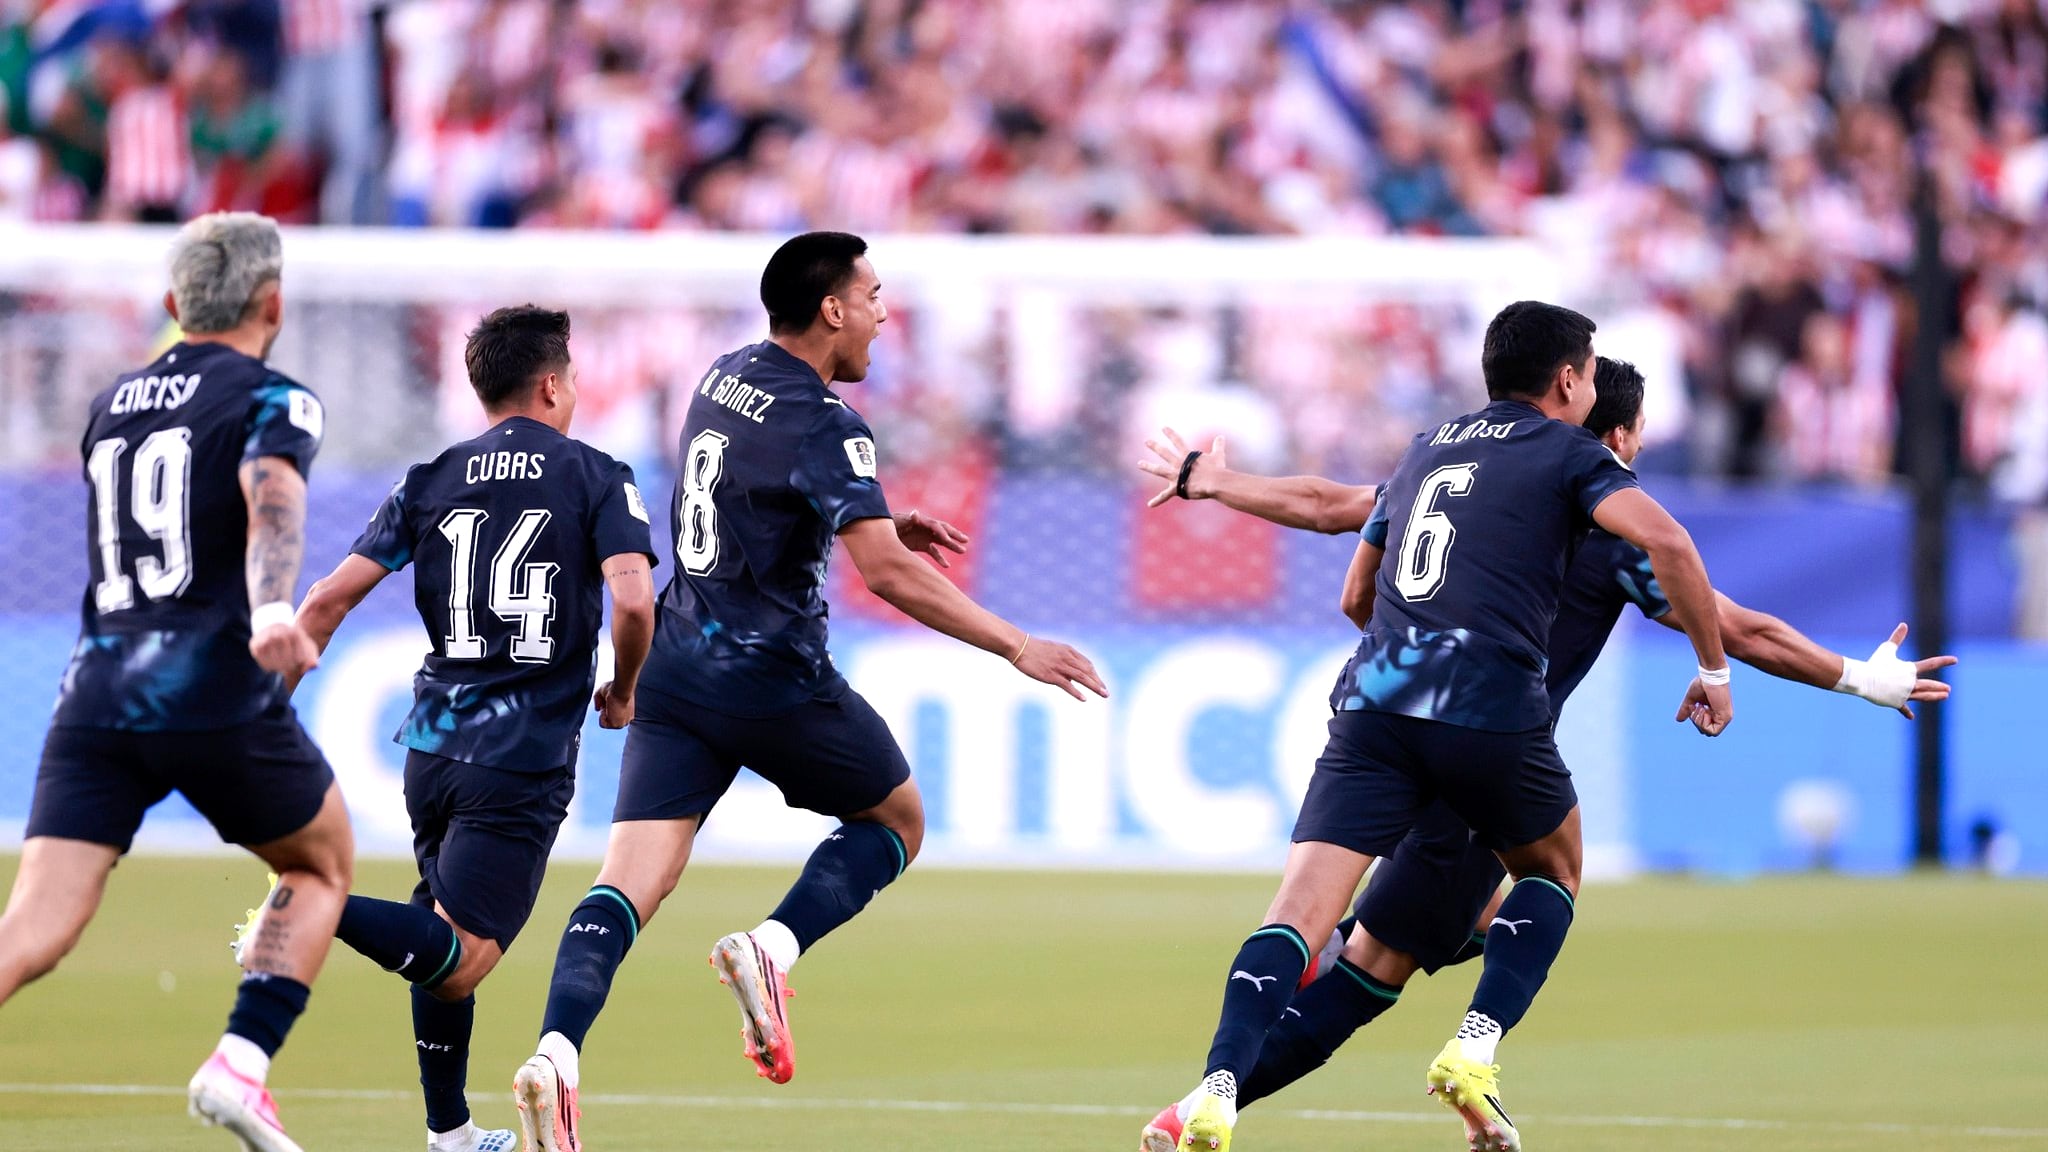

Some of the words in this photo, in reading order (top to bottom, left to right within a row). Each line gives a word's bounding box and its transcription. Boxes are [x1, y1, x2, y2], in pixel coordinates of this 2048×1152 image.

[109, 374, 201, 414] ENCISO
[712, 374, 776, 424] GÓMEZ
[1429, 419, 1516, 446] ALONSO
[466, 451, 545, 484] CUBAS
[87, 427, 194, 614] 19
[676, 430, 729, 577] 8
[1395, 463, 1479, 602] 6
[438, 509, 561, 664] 14
[569, 922, 610, 935] APF
[416, 1039, 453, 1052] APF
